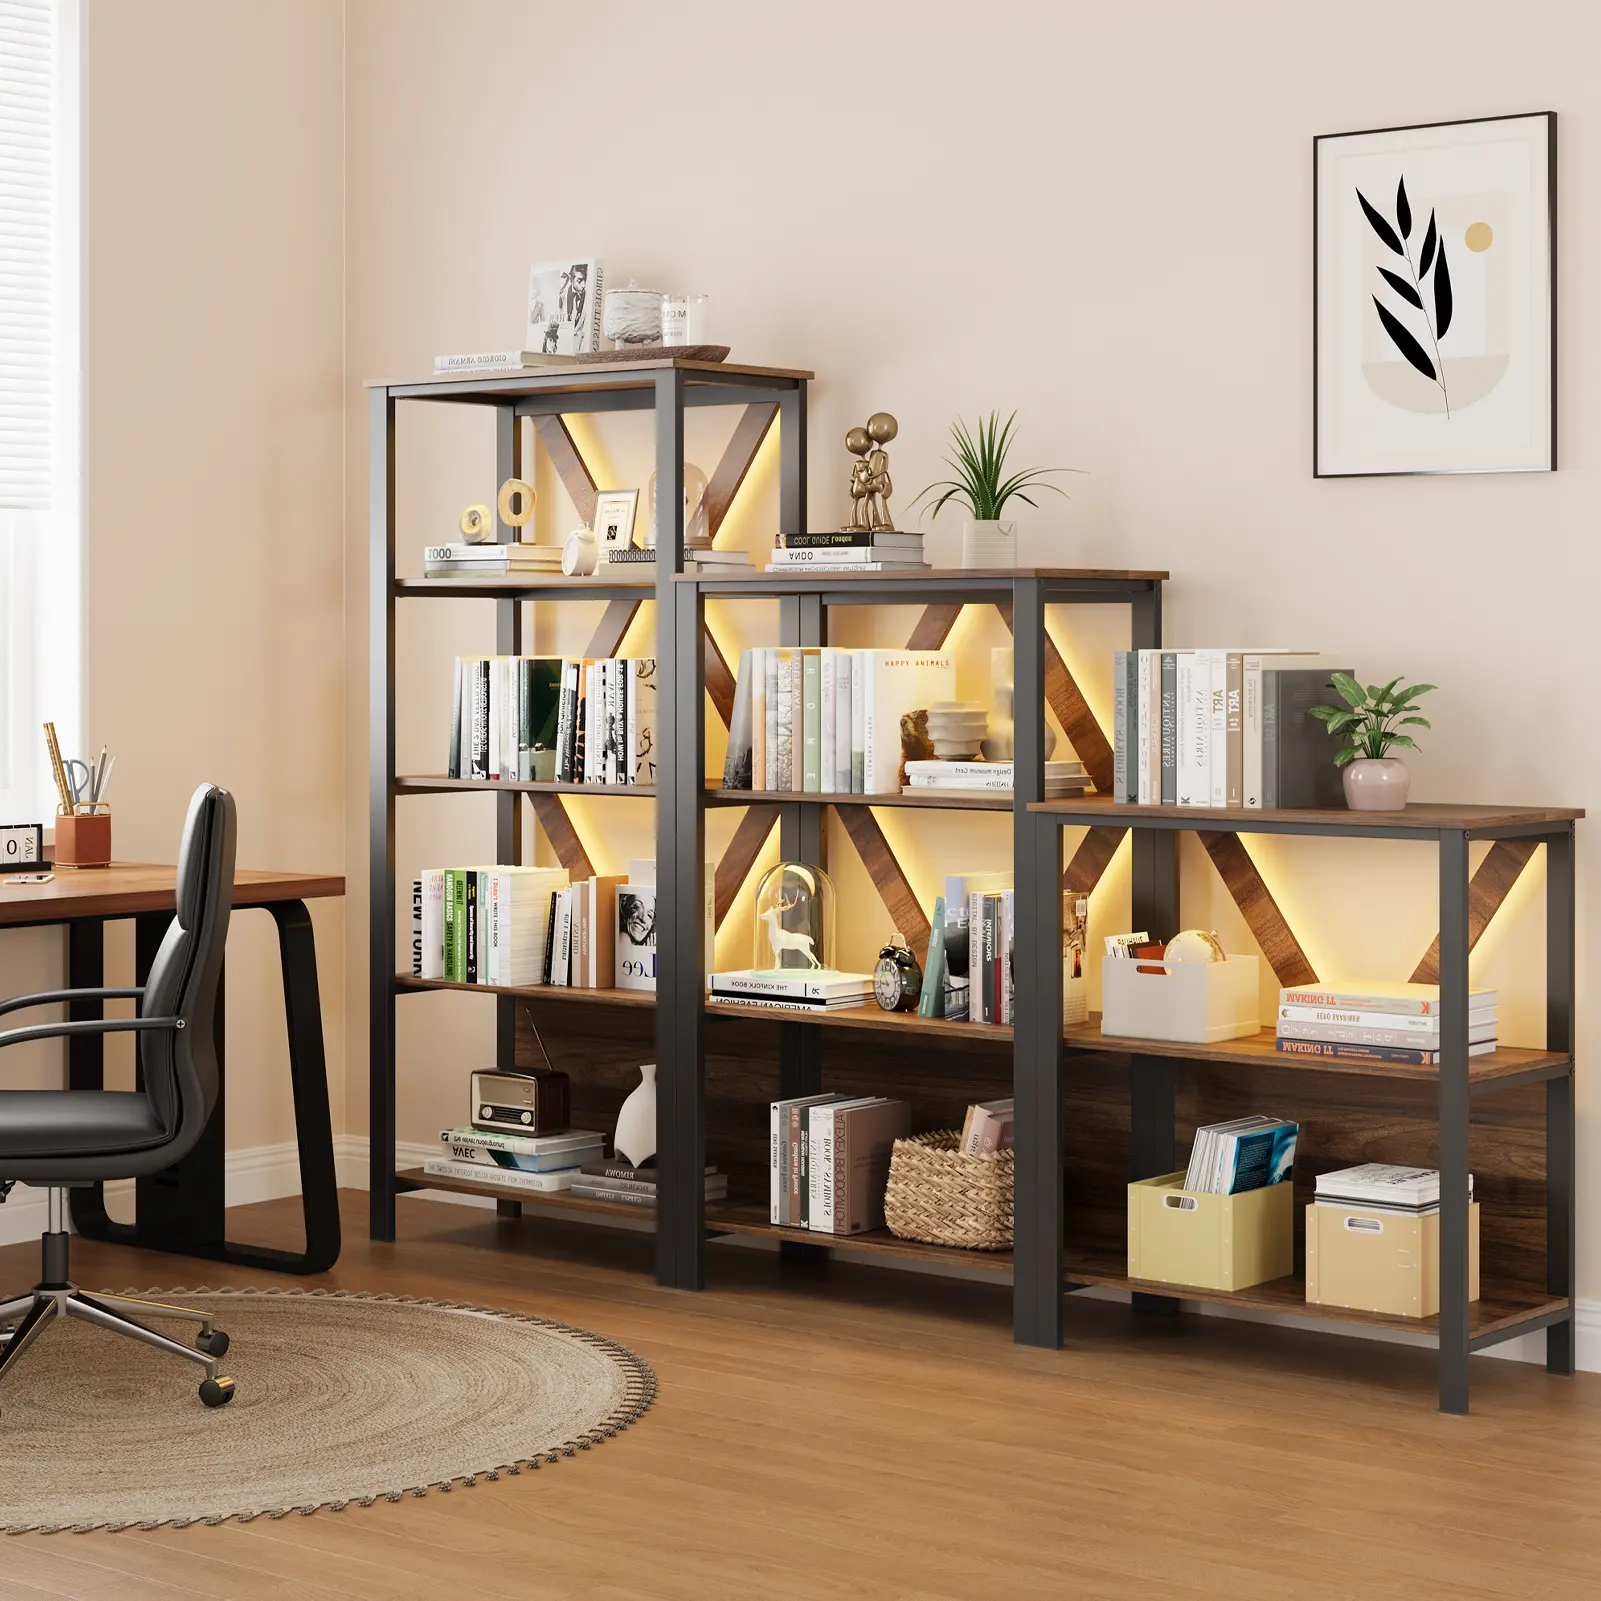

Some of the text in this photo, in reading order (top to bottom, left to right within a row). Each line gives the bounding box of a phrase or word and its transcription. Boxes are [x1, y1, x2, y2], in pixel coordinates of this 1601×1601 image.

[446, 873, 454, 901] HANDGUN
[446, 902, 454, 922] BASICS
[446, 922, 454, 942] SAFETY
[971, 927, 978, 936] BY
[474, 1170, 489, 1179] DESIGN
[507, 1174, 518, 1183] FROM
